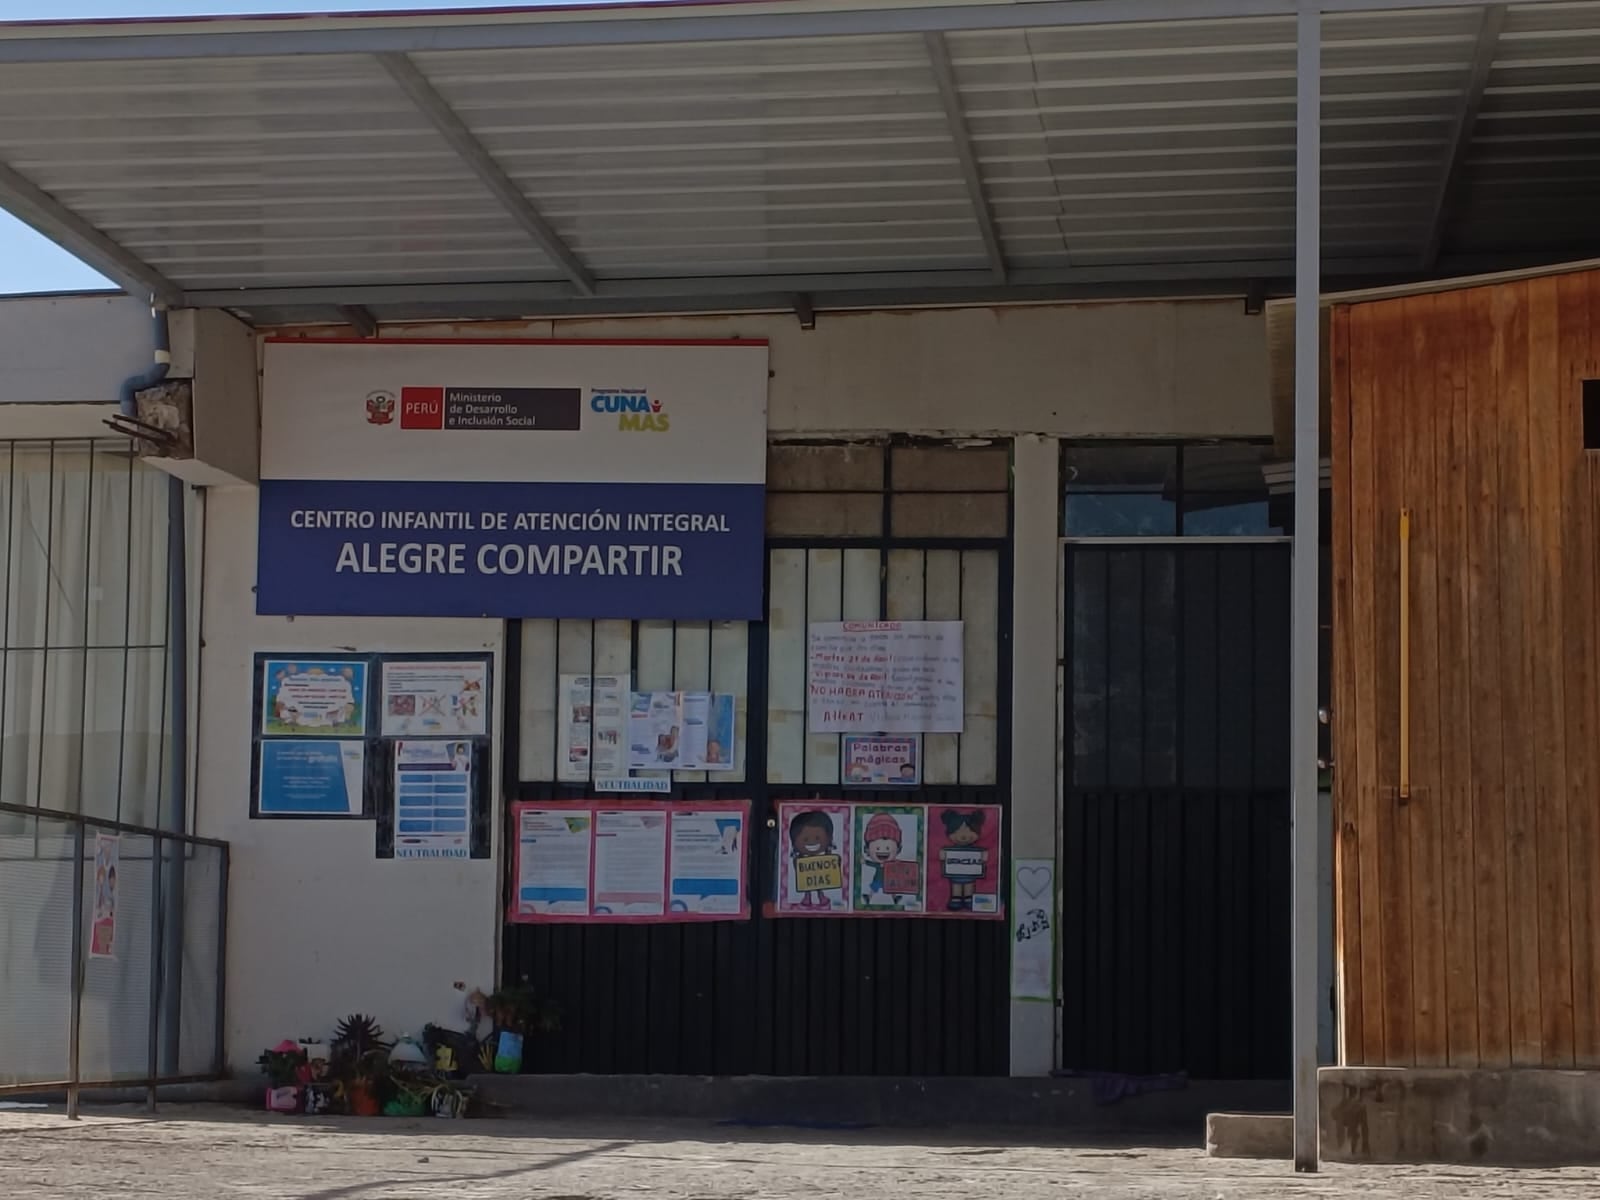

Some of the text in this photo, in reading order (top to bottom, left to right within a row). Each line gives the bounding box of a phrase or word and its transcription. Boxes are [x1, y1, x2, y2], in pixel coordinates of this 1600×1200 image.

[449, 392, 503, 403] Ministerio
[405, 400, 438, 414] PERÚ
[449, 404, 518, 414] de Desarrollo
[591, 395, 651, 413] CUNA
[448, 415, 536, 426] e Inclusión Social
[290, 508, 731, 532] CENTRO INFANTIL DE ATENCIÓN INTEGRAL
[335, 542, 684, 576] ALEGRE COMPARTIR
[853, 743, 908, 753] Palabras
[597, 779, 669, 791] NEUTRALIDAD
[396, 847, 467, 859] NEUTRALIDAD
[799, 858, 837, 873] BUENOS
